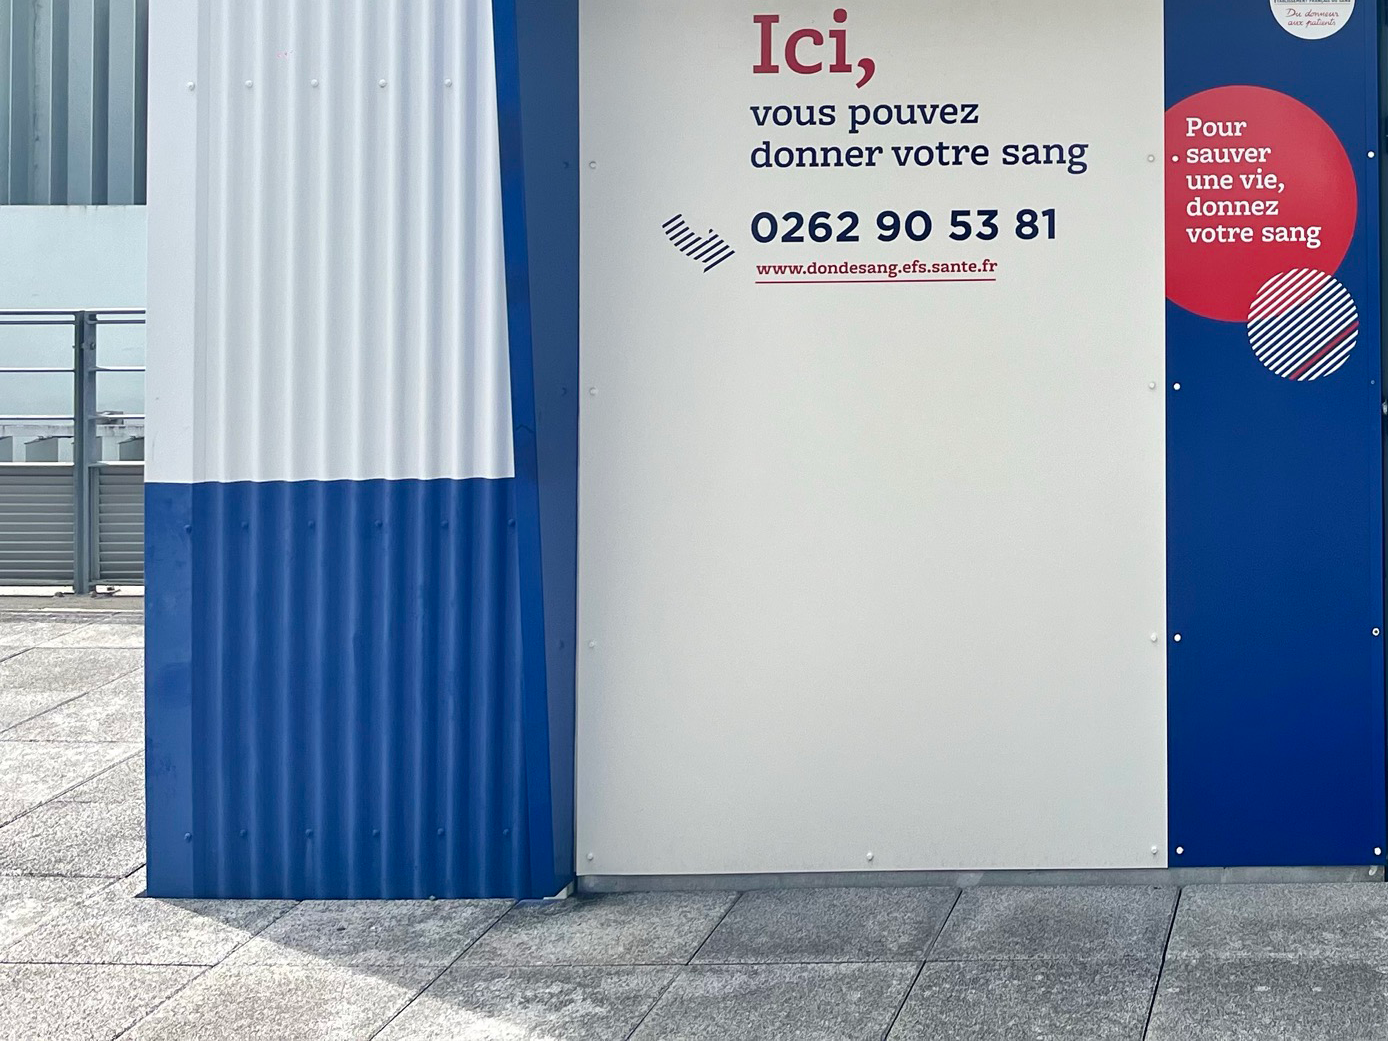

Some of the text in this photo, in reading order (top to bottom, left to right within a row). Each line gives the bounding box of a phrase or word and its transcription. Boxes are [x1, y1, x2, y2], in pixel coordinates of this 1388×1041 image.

[1285, 8, 1340, 18] Du donneur
[1305, 18, 1337, 29] patients
[751, 7, 877, 90] Ici,
[749, 102, 980, 134] vous pouvez
[1185, 116, 1248, 138] Pour
[750, 140, 1090, 175] donner votre sang
[1185, 145, 1273, 164] sauver
[1185, 168, 1286, 195] une vie,
[1185, 195, 1280, 217] donnez
[750, 207, 1058, 244] 0262 90 53 81
[1185, 223, 1323, 250] votre sang
[755, 258, 999, 279] www.dondesang.efs.sante.fr
